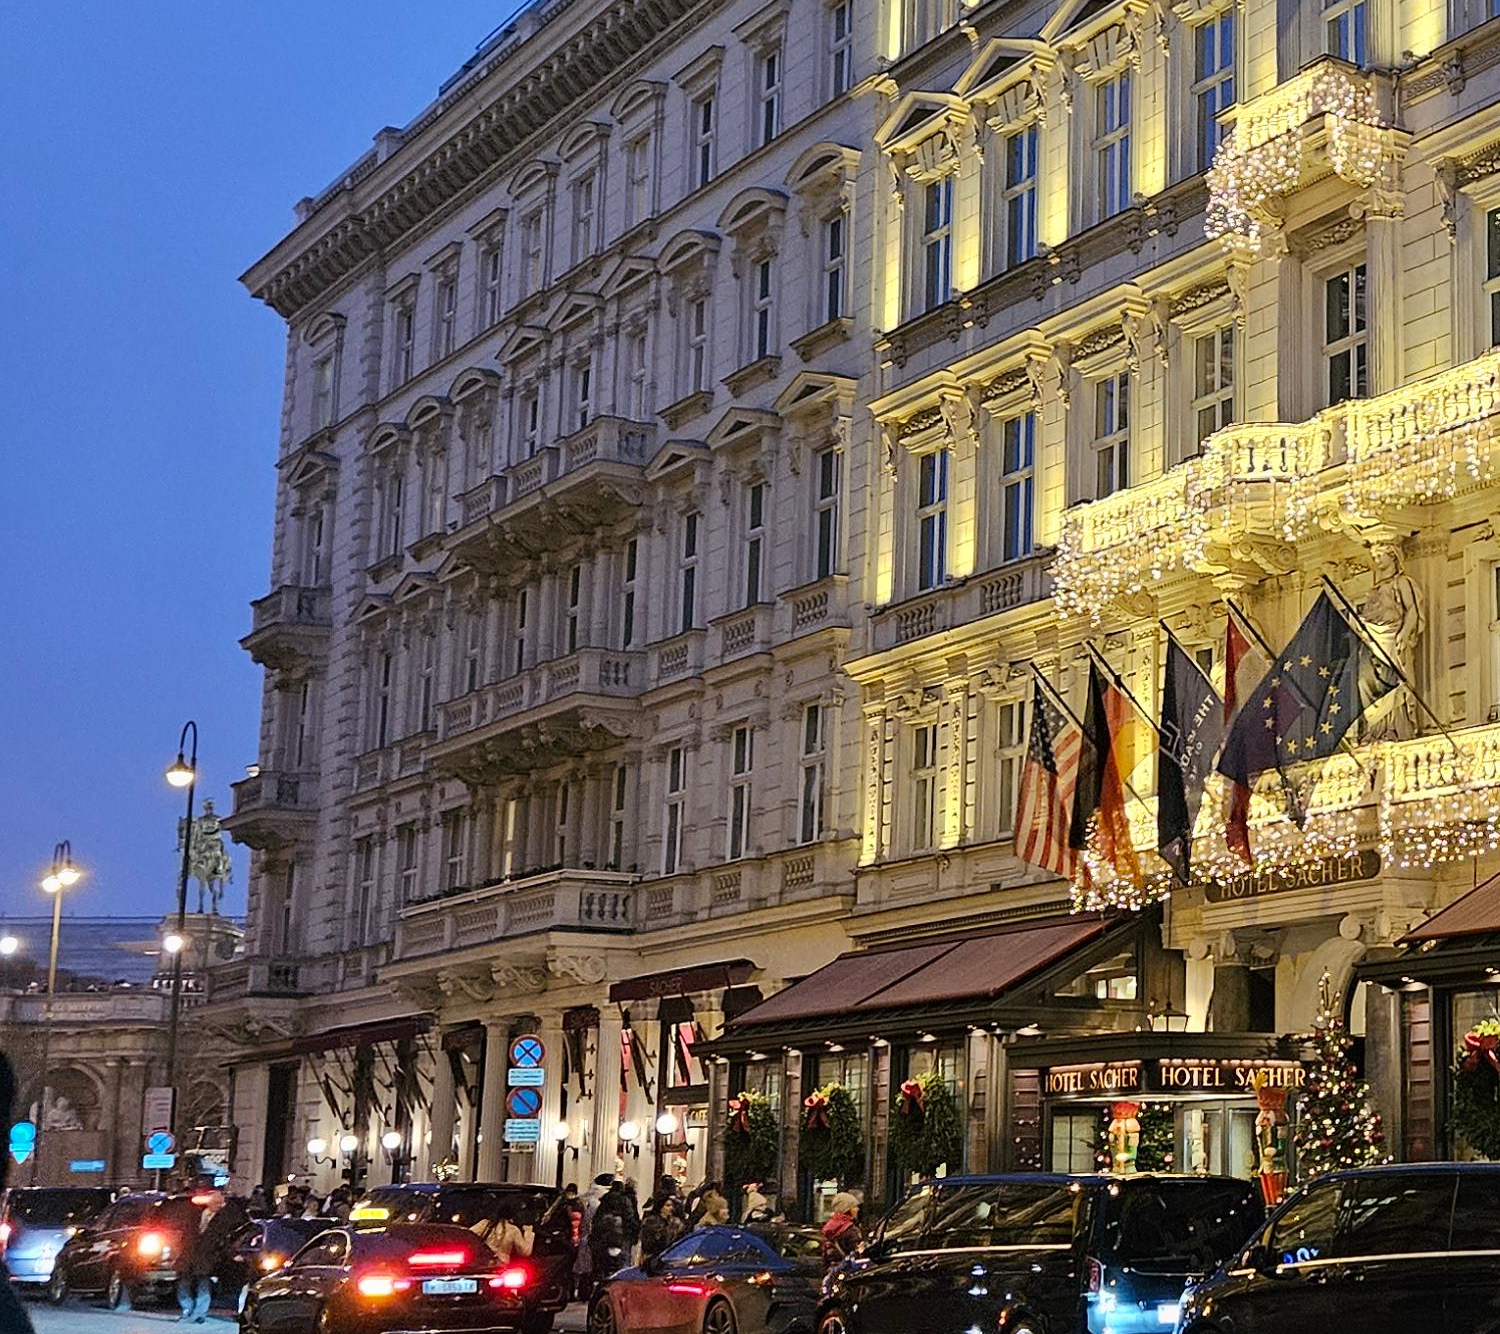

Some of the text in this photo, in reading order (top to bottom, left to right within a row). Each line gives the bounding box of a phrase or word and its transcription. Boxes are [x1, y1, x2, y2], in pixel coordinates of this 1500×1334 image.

[1221, 855, 1365, 899] HOTEL SACHER
[1045, 1067, 1138, 1093] HOTEL SACHER
[1161, 1066, 1307, 1088] HOTEL SACHER
